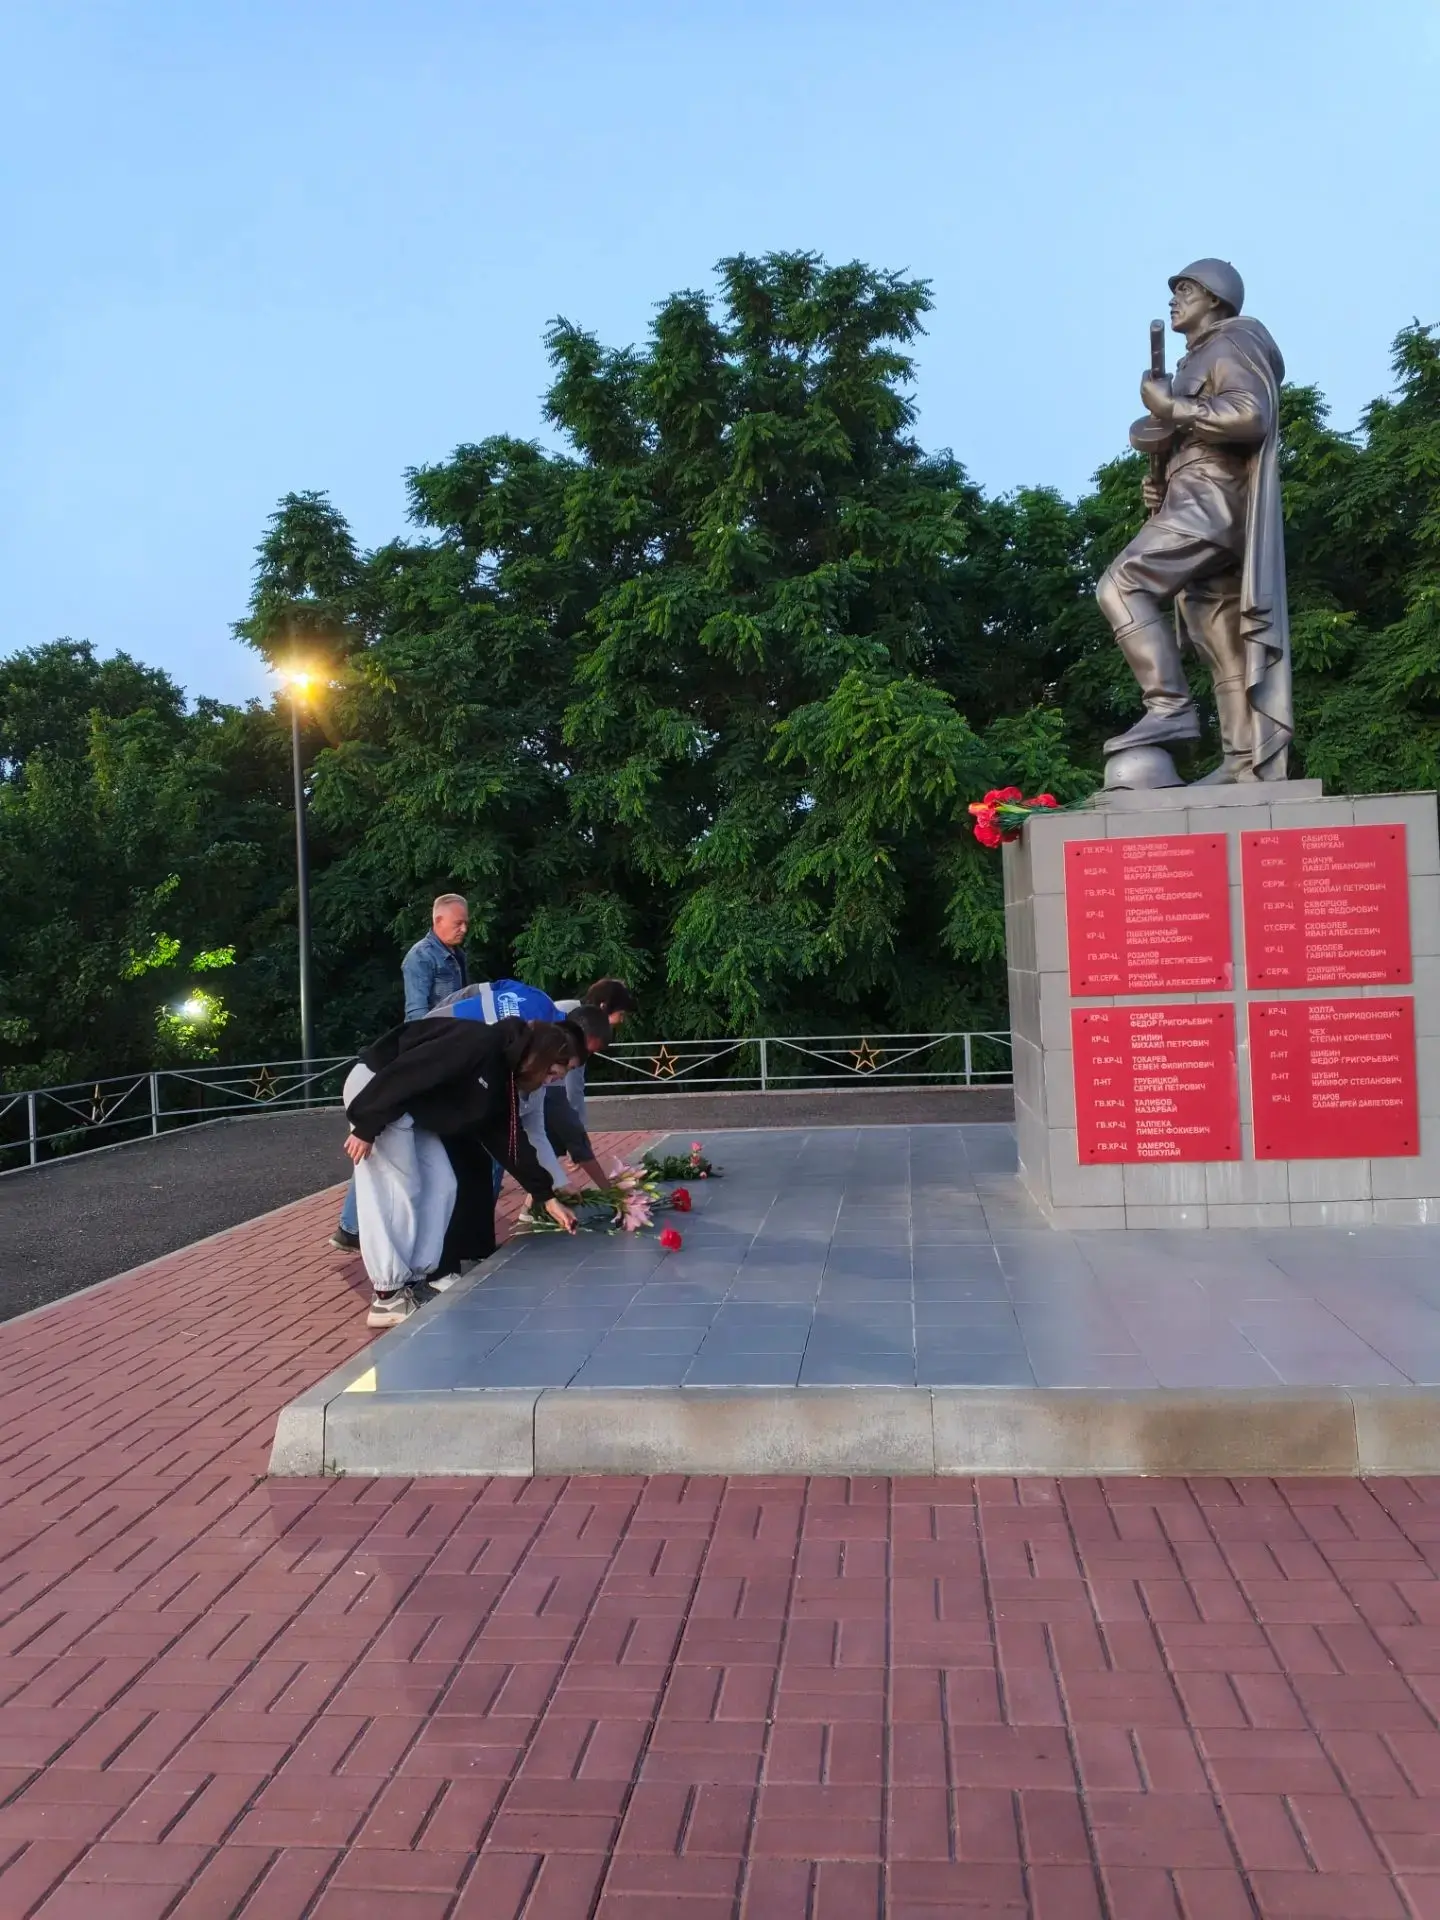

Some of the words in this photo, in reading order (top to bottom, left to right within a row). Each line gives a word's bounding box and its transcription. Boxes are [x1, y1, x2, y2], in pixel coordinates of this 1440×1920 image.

[1302, 834, 1339, 842] САБИТОВ
[1302, 856, 1334, 864] САЙЧУК
[1344, 884, 1385, 892] ПЕТРОВИЧ
[1155, 892, 1202, 900] ФЕДОРОВИЧ
[1304, 900, 1348, 908] СКВОРЦОВ
[1328, 906, 1379, 914] ФЕДОРОВИЧ
[1166, 913, 1209, 921] ПАВЛОВИЧ
[1306, 929, 1327, 937] ИВАН
[1329, 928, 1380, 936] АЛЕКСЕЕВИЧ
[1306, 944, 1343, 952] СОБОЛЕВ
[1306, 951, 1336, 959] ГАВРИЛ
[1333, 1012, 1400, 1020] СПИРИДОНОВИЧ
[1130, 1020, 1157, 1028] ФЕДОР
[1159, 1018, 1212, 1026] ГРИГОРЬЕВИЧ
[1269, 1029, 1287, 1037] КР-Ц
[1310, 1035, 1341, 1043] СТЕПАН
[1167, 1040, 1209, 1048] ПЕТРОВИЧ
[1311, 1057, 1339, 1065] ФЕДОР
[1133, 1063, 1159, 1071] СЕМЕН
[1134, 1075, 1178, 1084] ТРУБИЦКОЙ
[1350, 1077, 1402, 1085] СТЕПАНОВИЧ
[1358, 1099, 1403, 1107] ДАВЛЕТОВИЧ
[1135, 1104, 1178, 1113] НАЗАРБАЙ
[1138, 1148, 1181, 1156] ТОШКУЛАЙ
